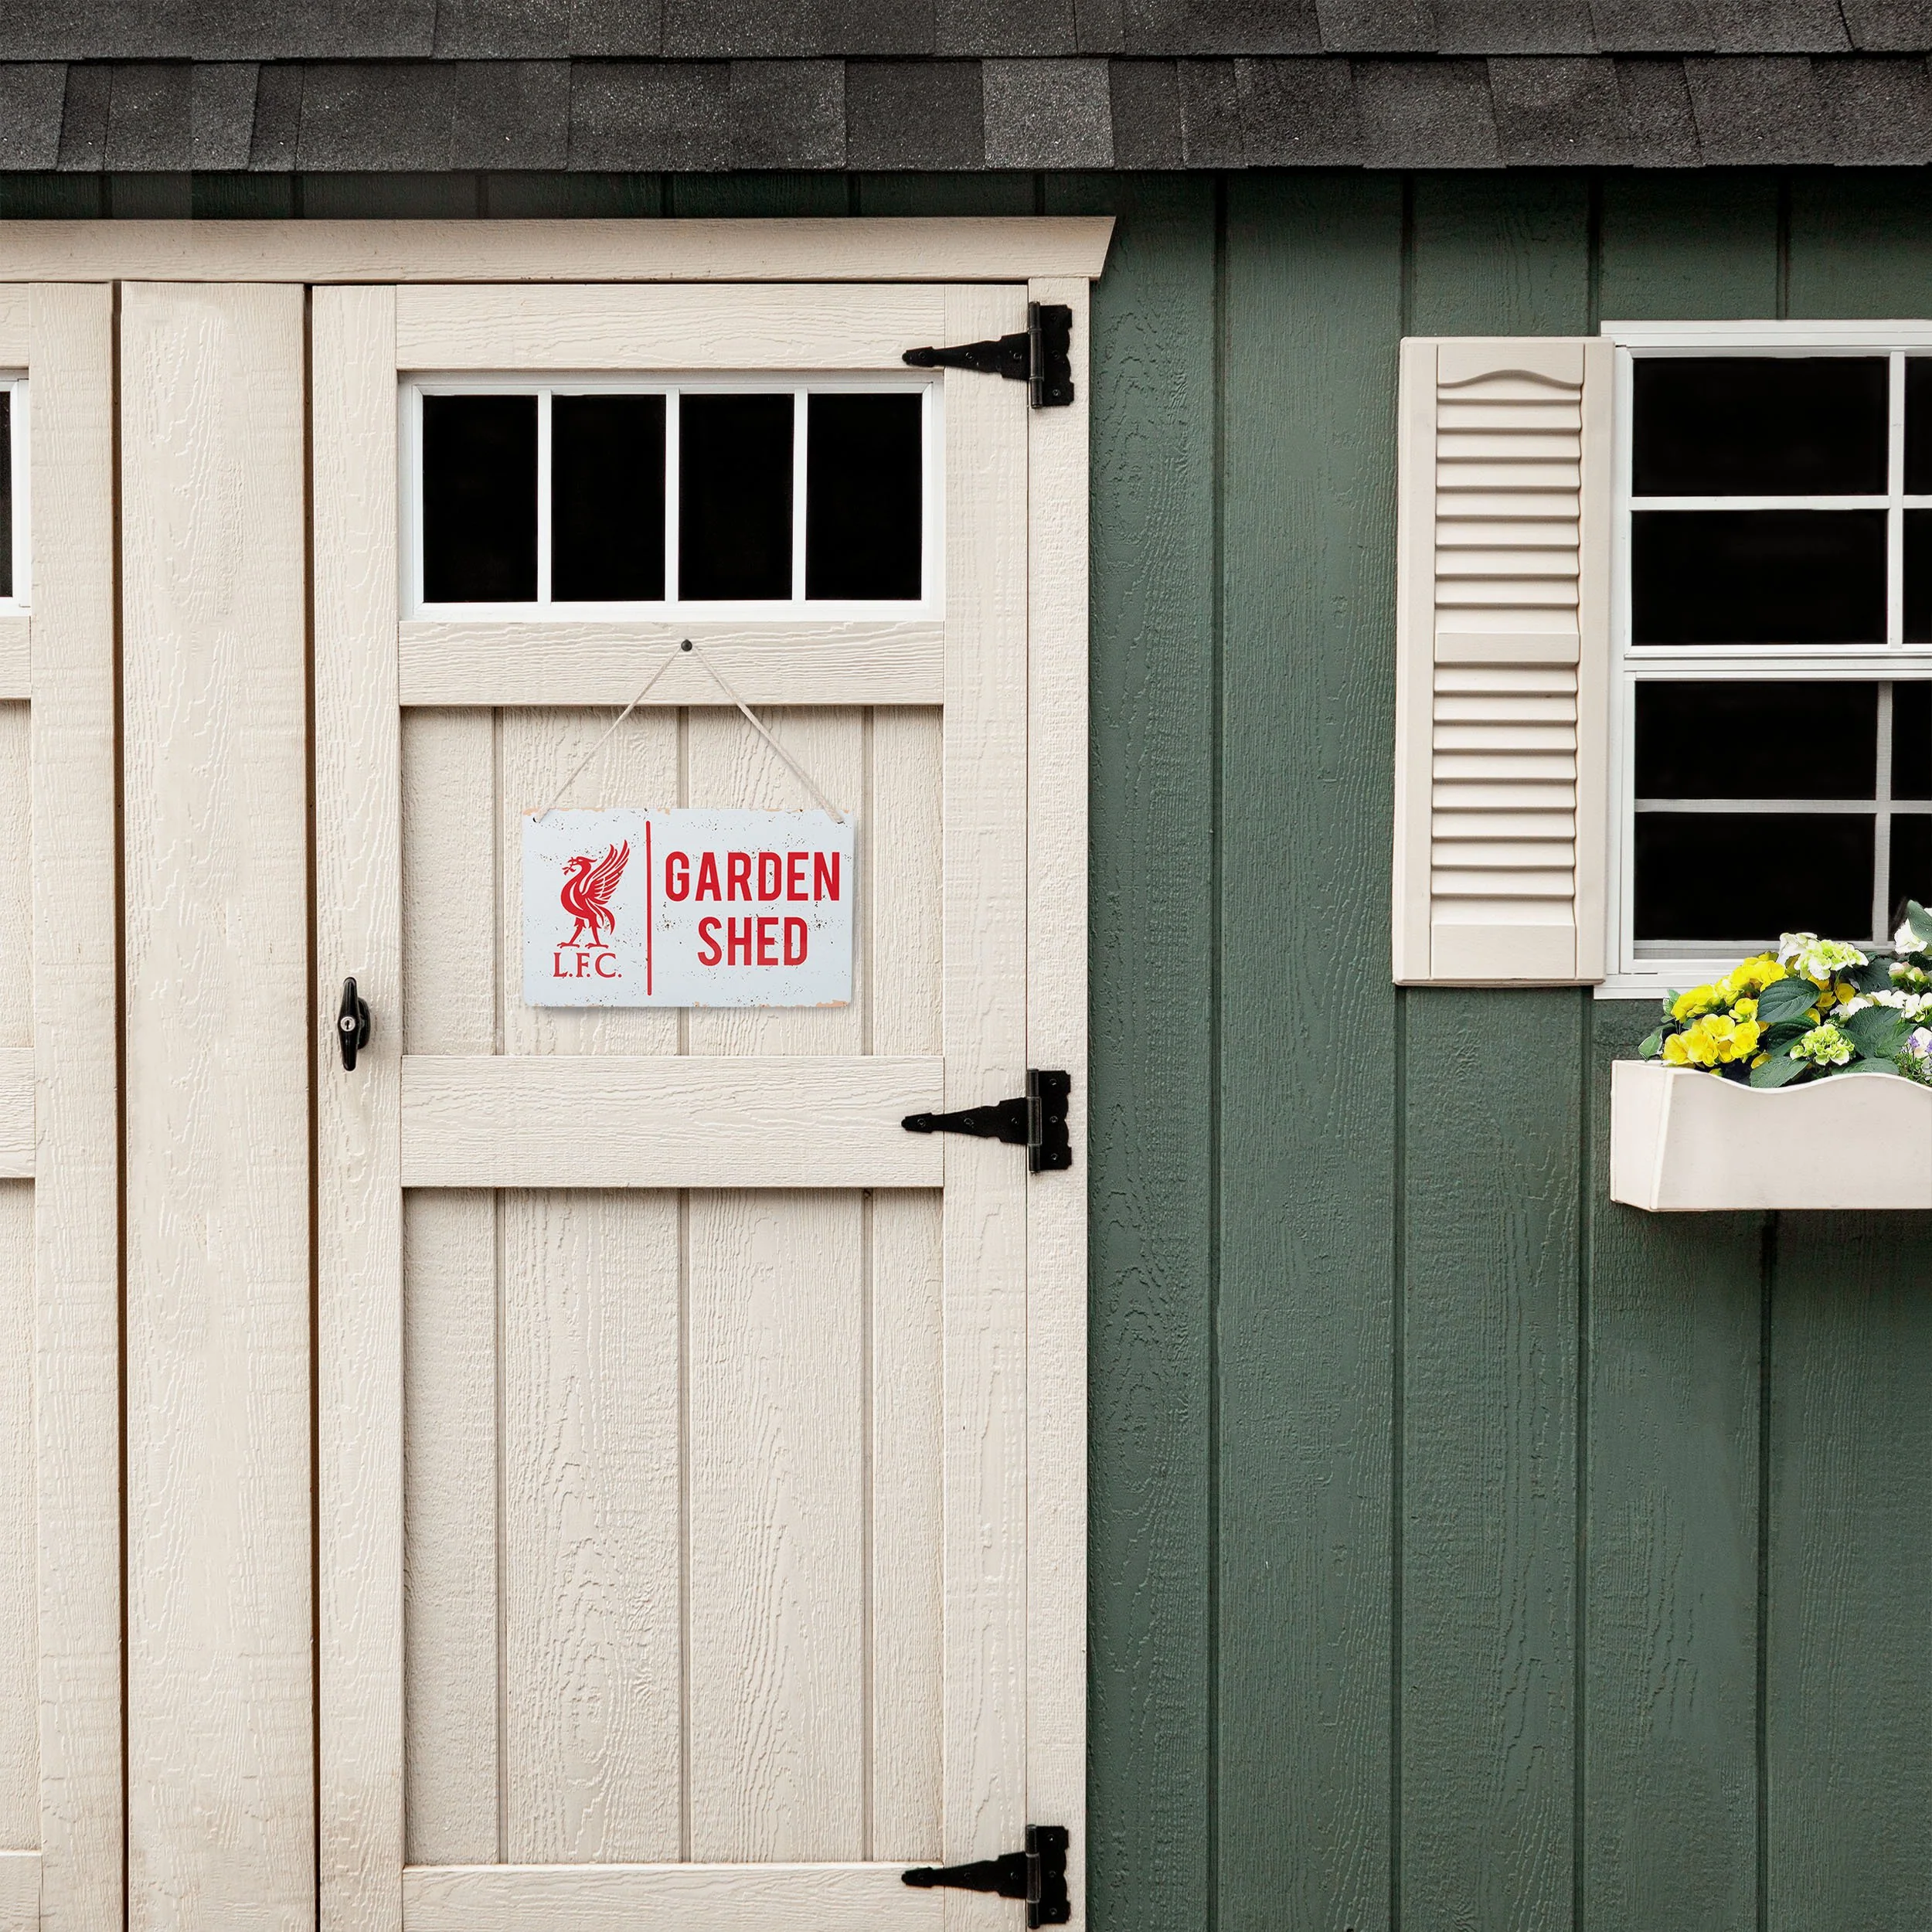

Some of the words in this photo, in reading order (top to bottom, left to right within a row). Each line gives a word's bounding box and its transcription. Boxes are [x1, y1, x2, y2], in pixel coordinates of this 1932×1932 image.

[665, 851, 841, 902] GARDEN
[553, 952, 622, 978] L.F.C.
[697, 917, 808, 966] SHED
